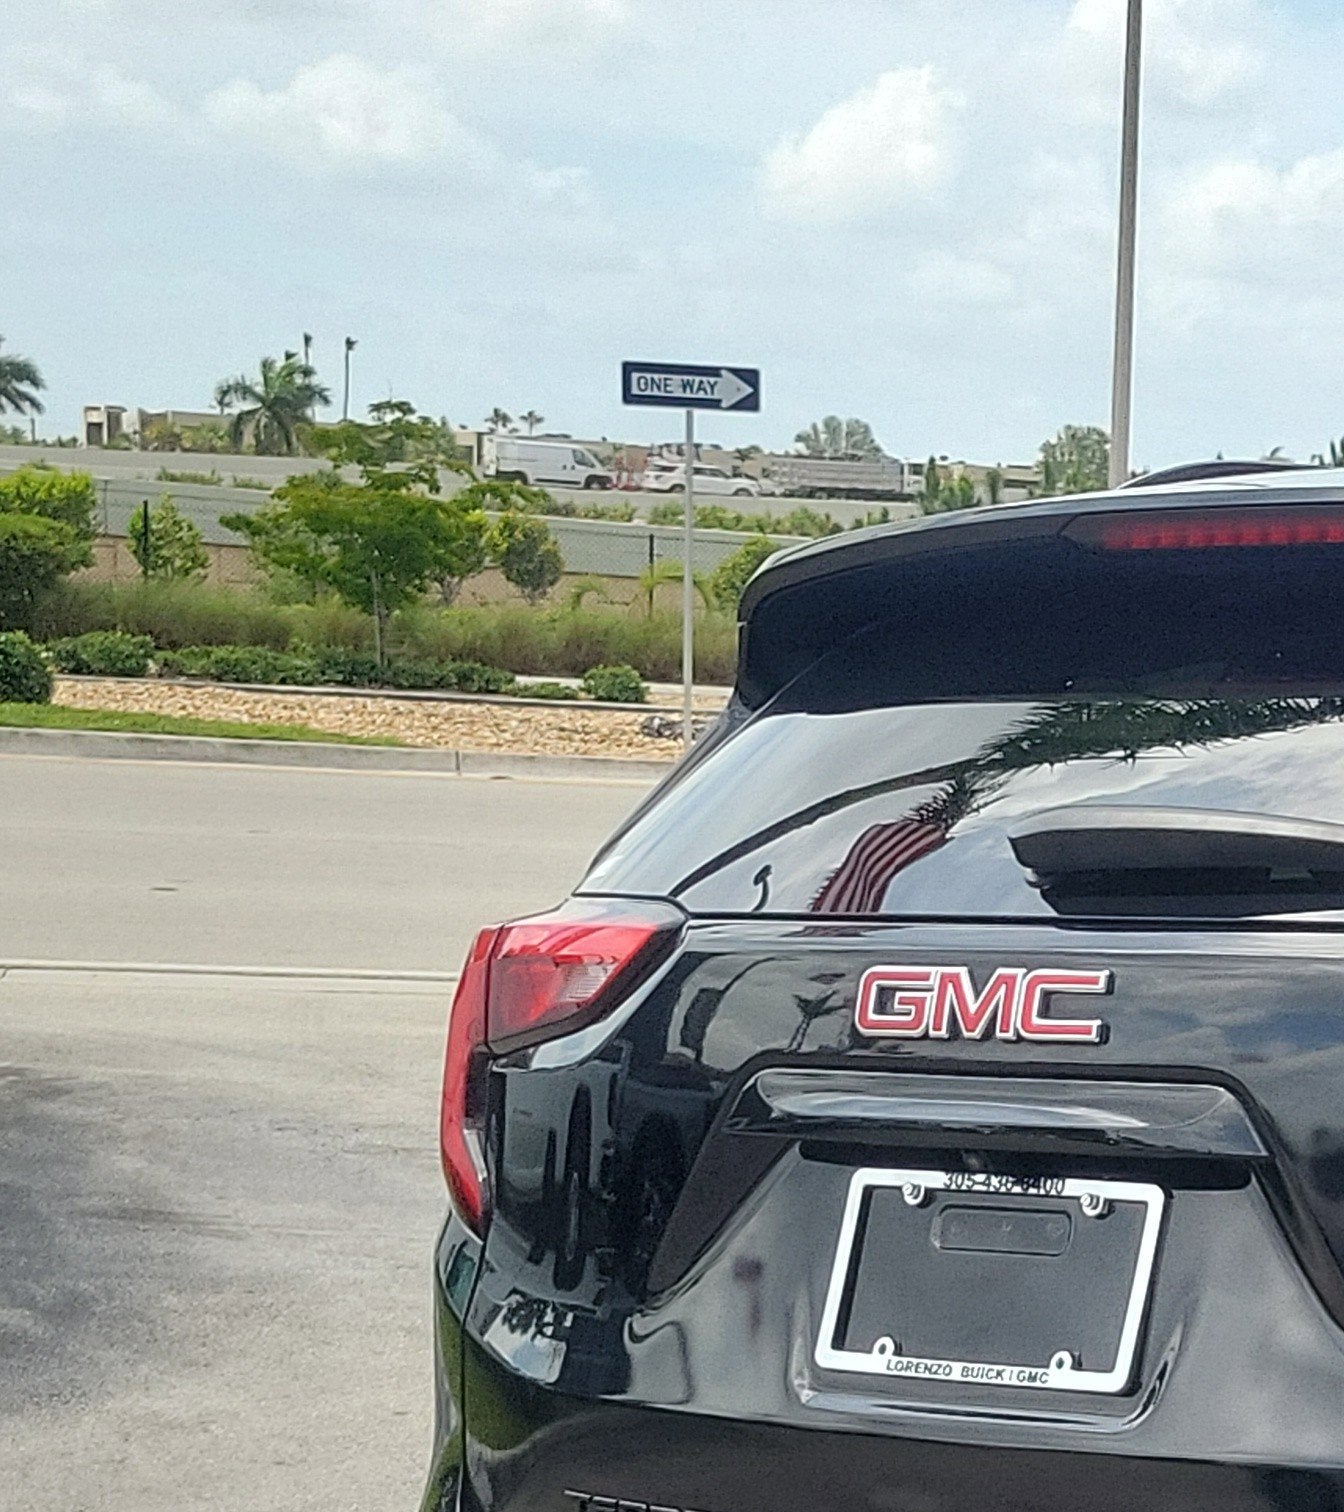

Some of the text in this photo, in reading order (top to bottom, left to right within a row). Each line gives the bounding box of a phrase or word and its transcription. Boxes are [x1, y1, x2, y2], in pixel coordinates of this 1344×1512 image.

[637, 375, 718, 396] ONE WAY
[855, 965, 1112, 1043] GMC
[886, 1358, 953, 1377] LORENZO
[960, 1365, 1006, 1382] BUICK
[1015, 1369, 1050, 1384] GMC
